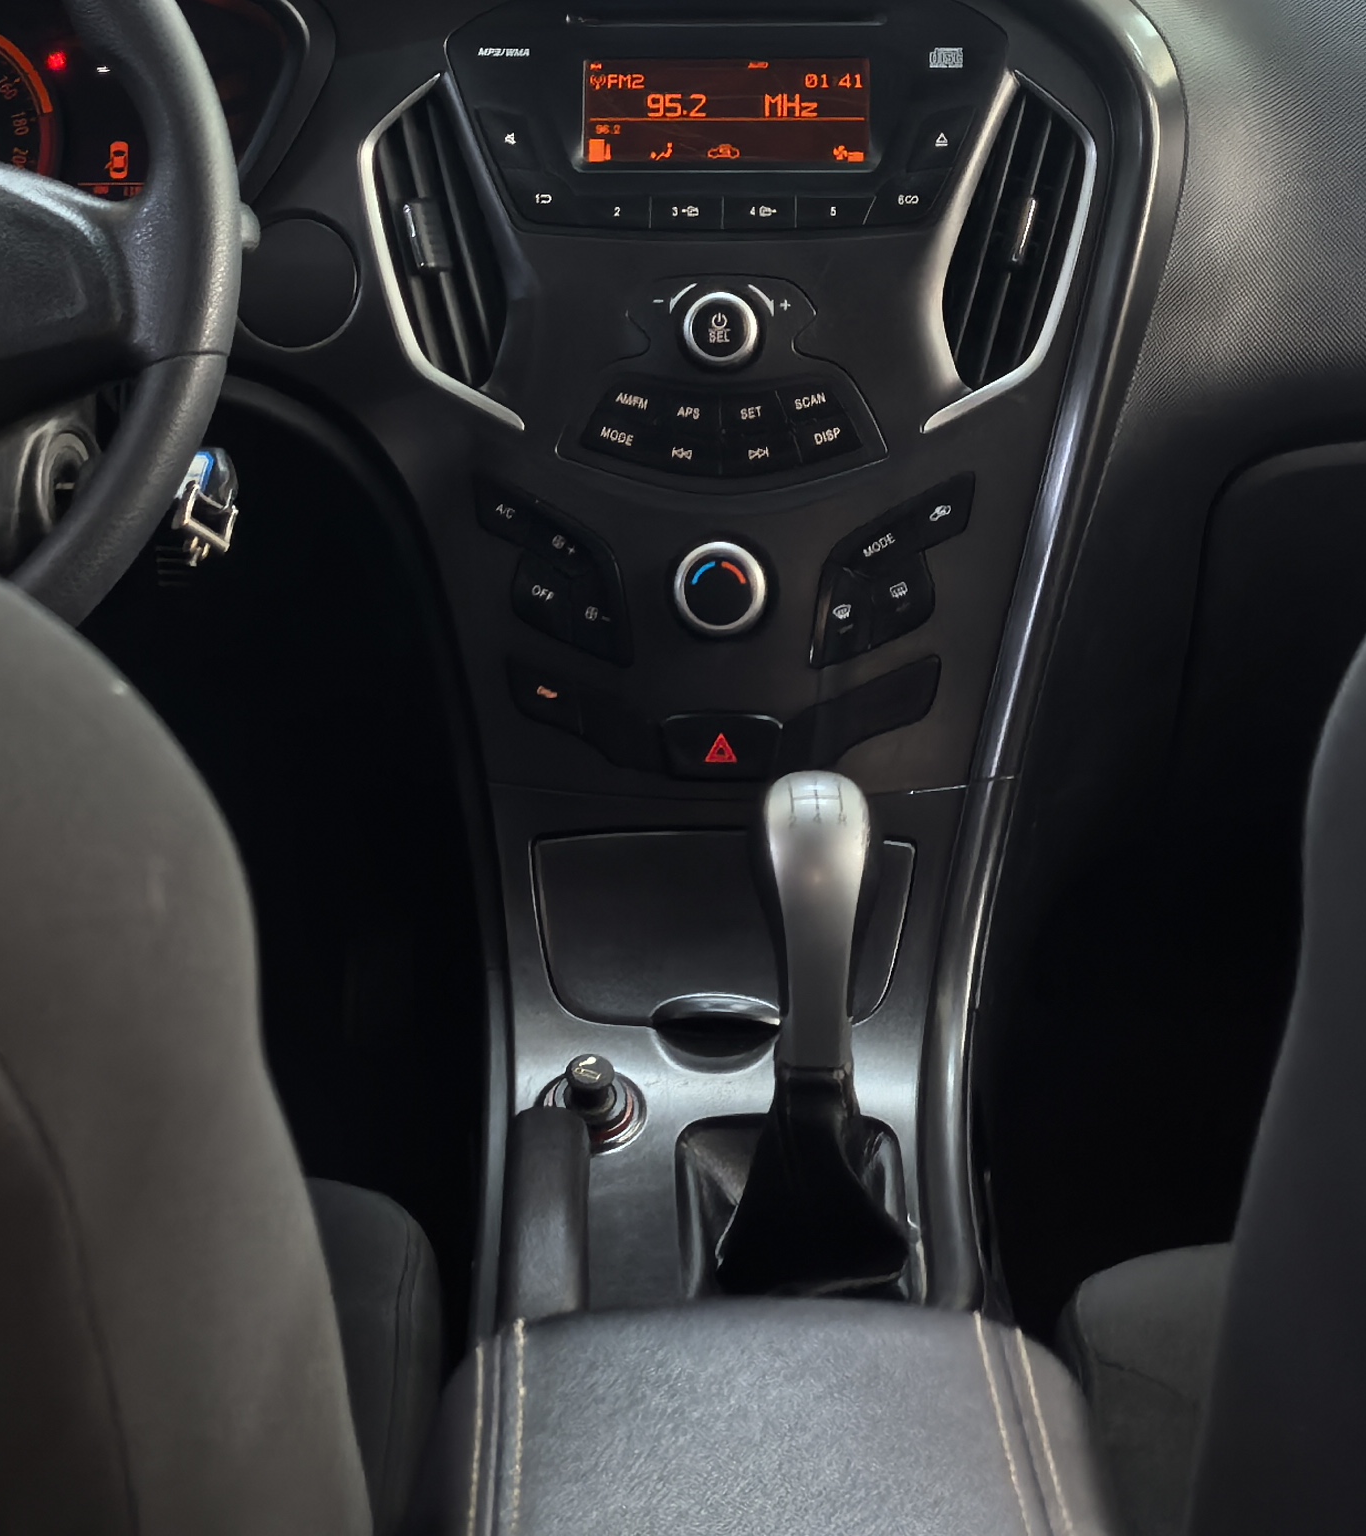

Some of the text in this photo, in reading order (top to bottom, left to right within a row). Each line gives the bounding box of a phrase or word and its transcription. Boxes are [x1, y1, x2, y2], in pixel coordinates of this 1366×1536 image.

[478, 47, 530, 57] MP3/WMA
[607, 74, 645, 89] FM2
[646, 93, 819, 118] 95.2 MHz
[11, 112, 30, 136] 180
[12, 147, 29, 169] 20
[613, 207, 620, 217] 2
[672, 207, 678, 217] 3
[750, 207, 756, 216] 4
[830, 207, 836, 217] 5
[794, 392, 826, 410] SCAN
[677, 406, 700, 419] APS
[741, 405, 762, 420] SET
[600, 426, 634, 446] MODE
[814, 427, 841, 445] DISP
[495, 503, 515, 520] A/C
[863, 532, 896, 558] MODE
[532, 584, 555, 602] OFF
